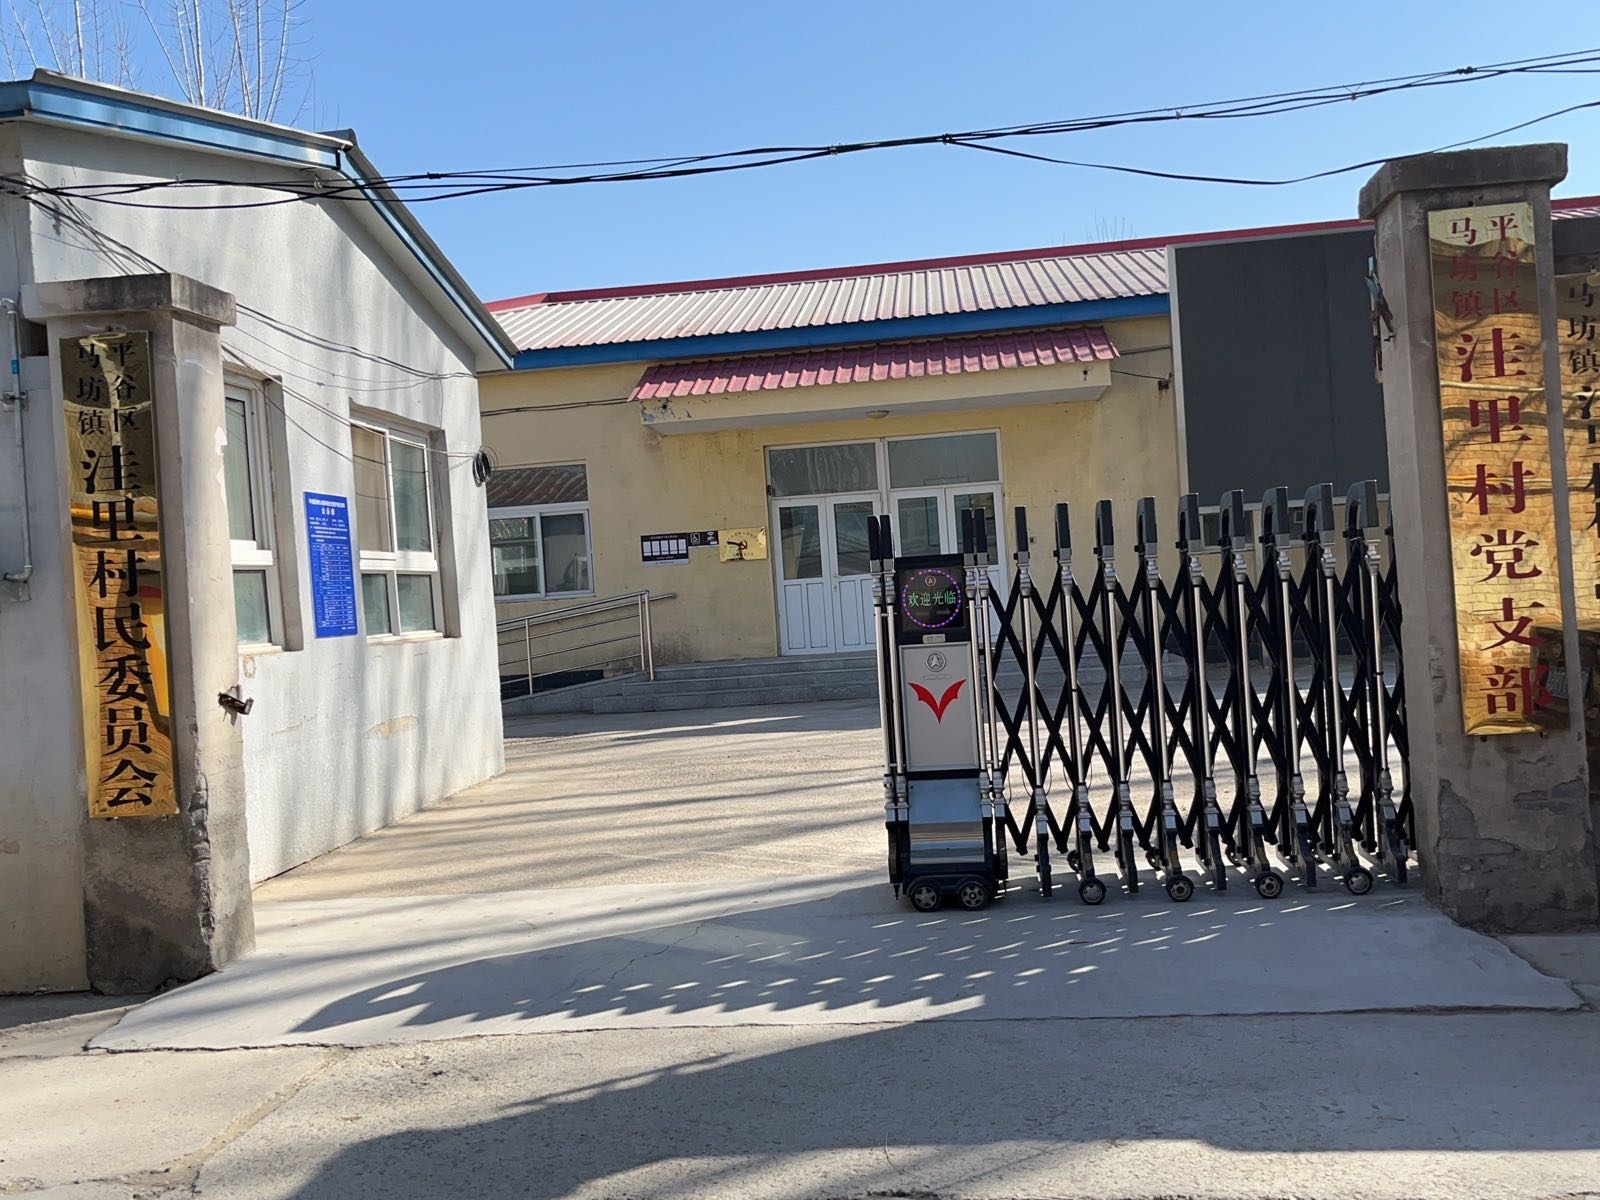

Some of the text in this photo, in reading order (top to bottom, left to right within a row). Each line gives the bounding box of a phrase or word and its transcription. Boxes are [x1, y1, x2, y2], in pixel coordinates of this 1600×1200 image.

[1447, 218, 1483, 318] 马坊镇
[1486, 212, 1522, 315] 平谷区
[76, 341, 106, 436] 马坊镇
[108, 341, 139, 433] 平谷区
[1454, 328, 1551, 717] 洼里村党支部
[82, 446, 158, 808] 洼里村民委员会
[907, 590, 957, 607] 欢迎光临
